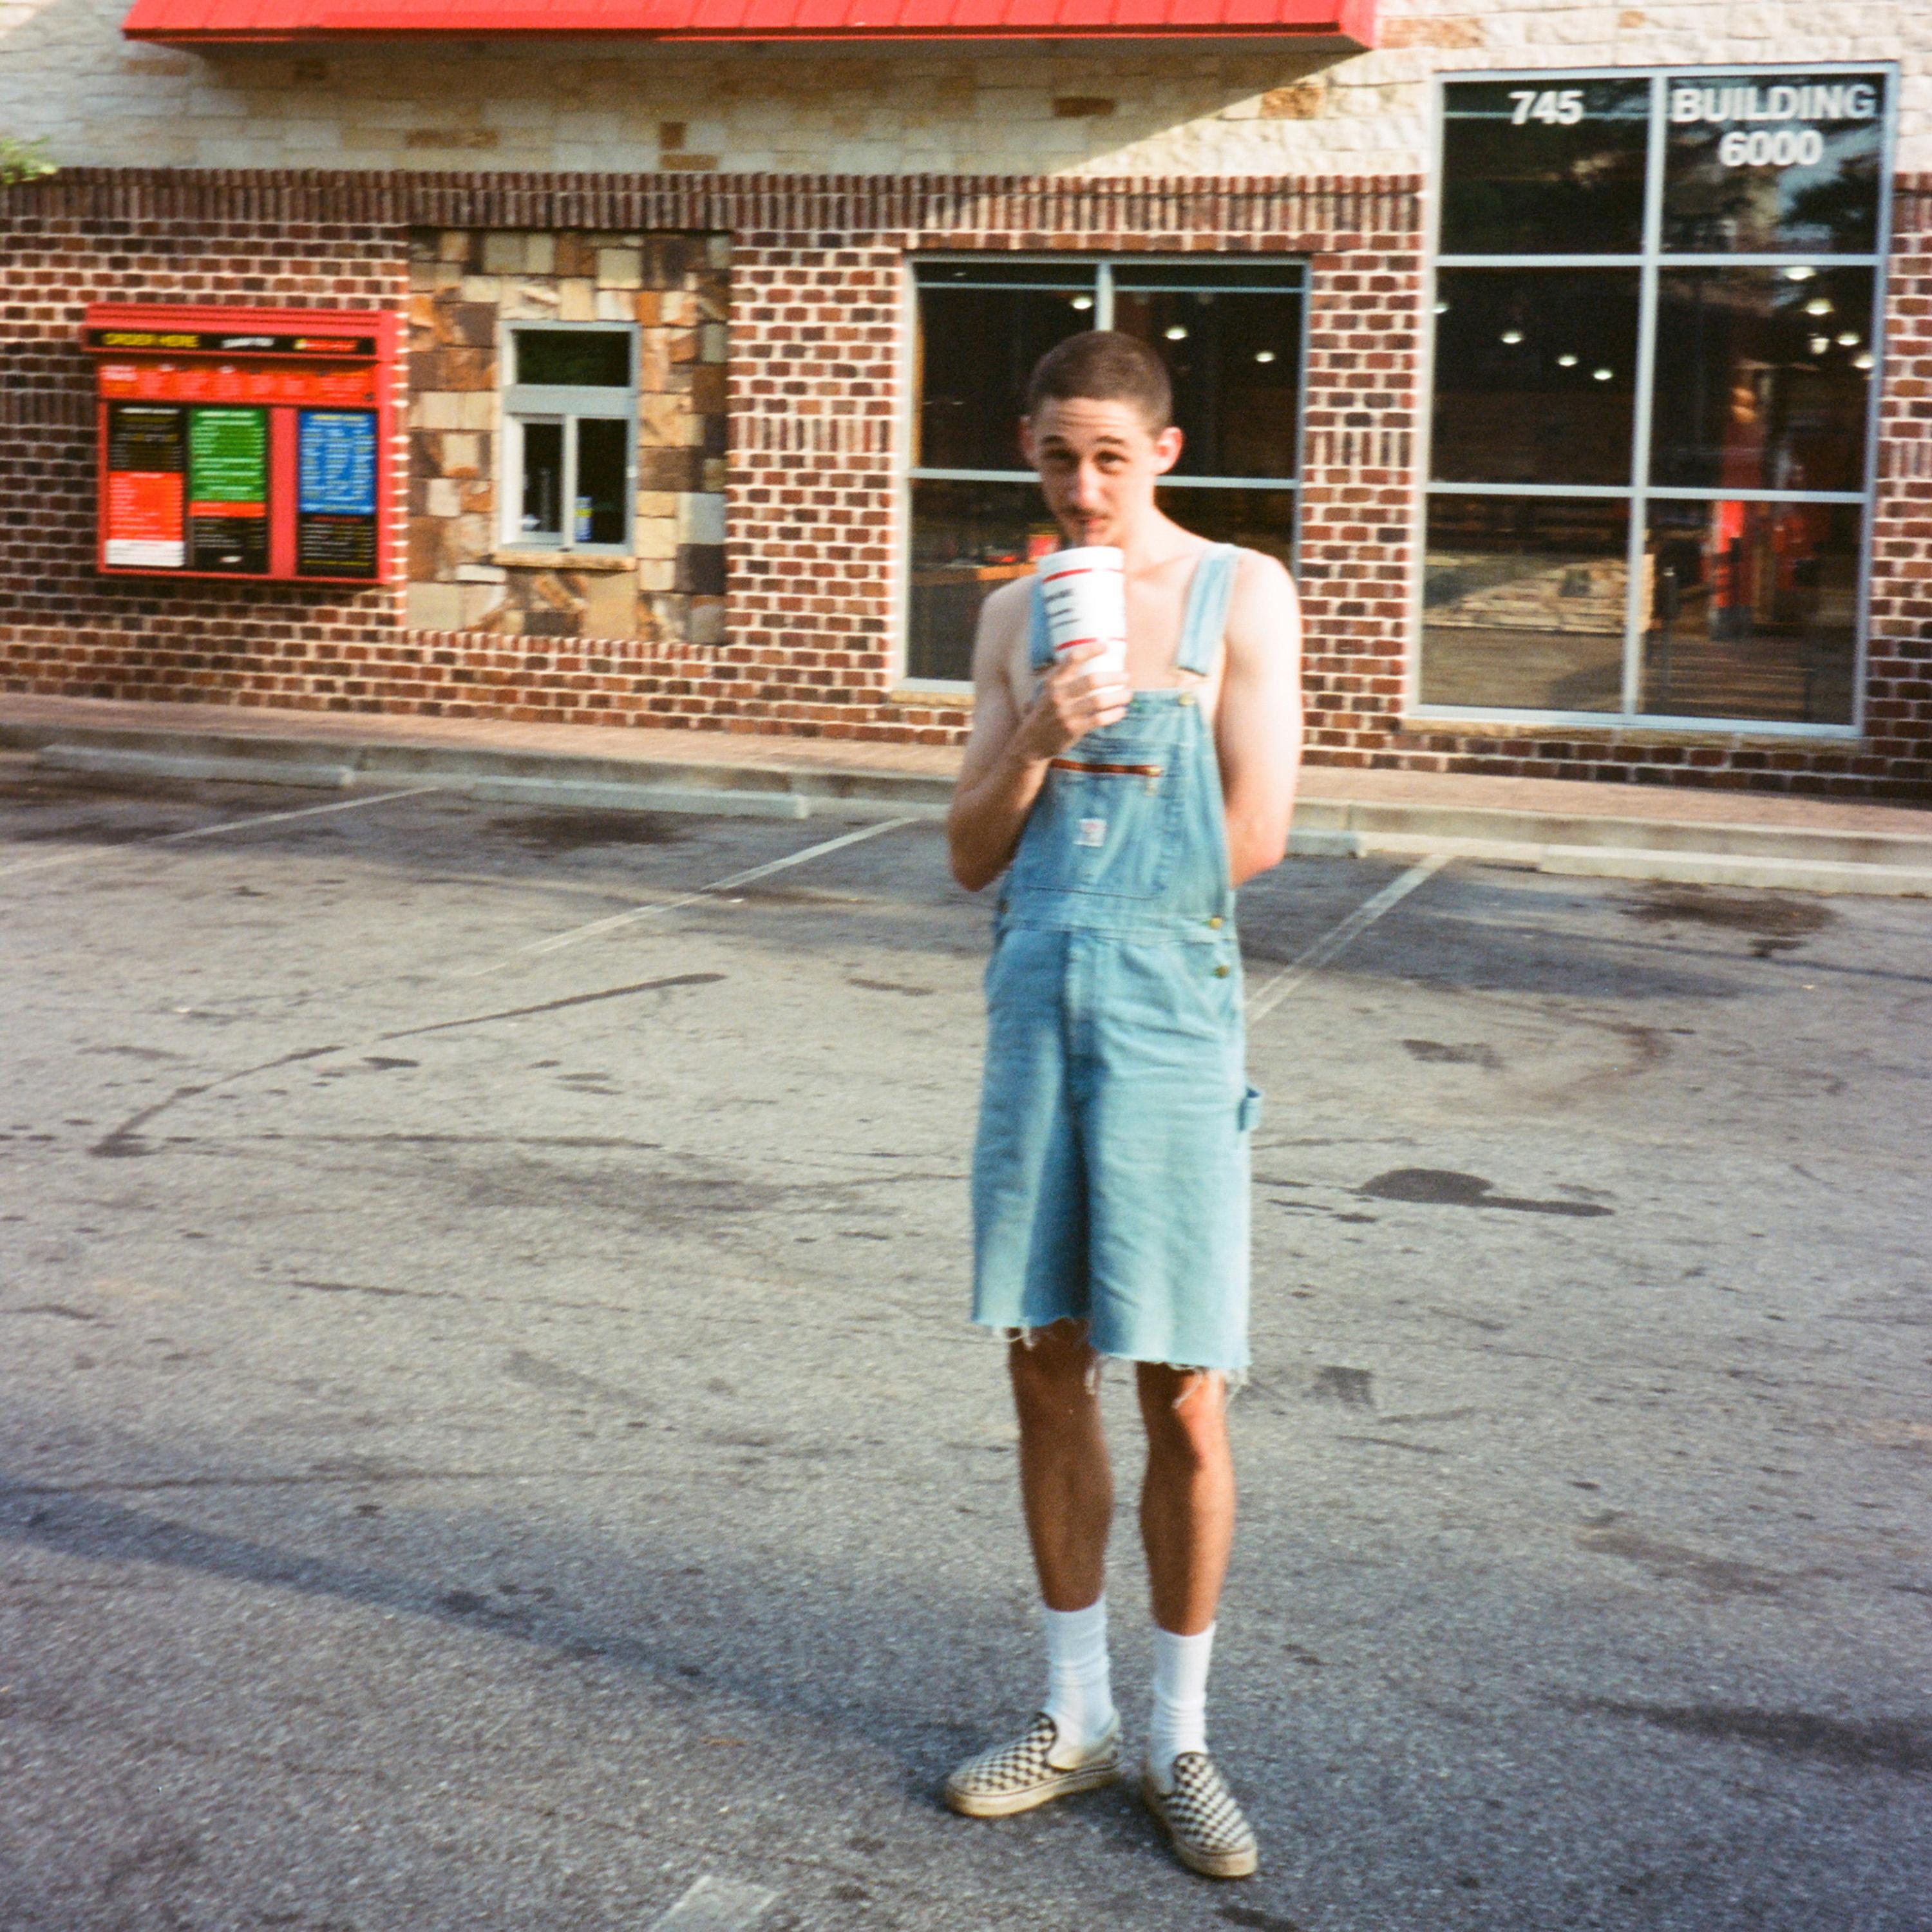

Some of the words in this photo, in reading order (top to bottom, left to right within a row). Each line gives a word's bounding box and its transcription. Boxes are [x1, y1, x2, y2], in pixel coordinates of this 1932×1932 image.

[1509, 90, 1584, 125] 745
[1672, 84, 1877, 121] BUILDING
[1719, 129, 1824, 167] 6000
